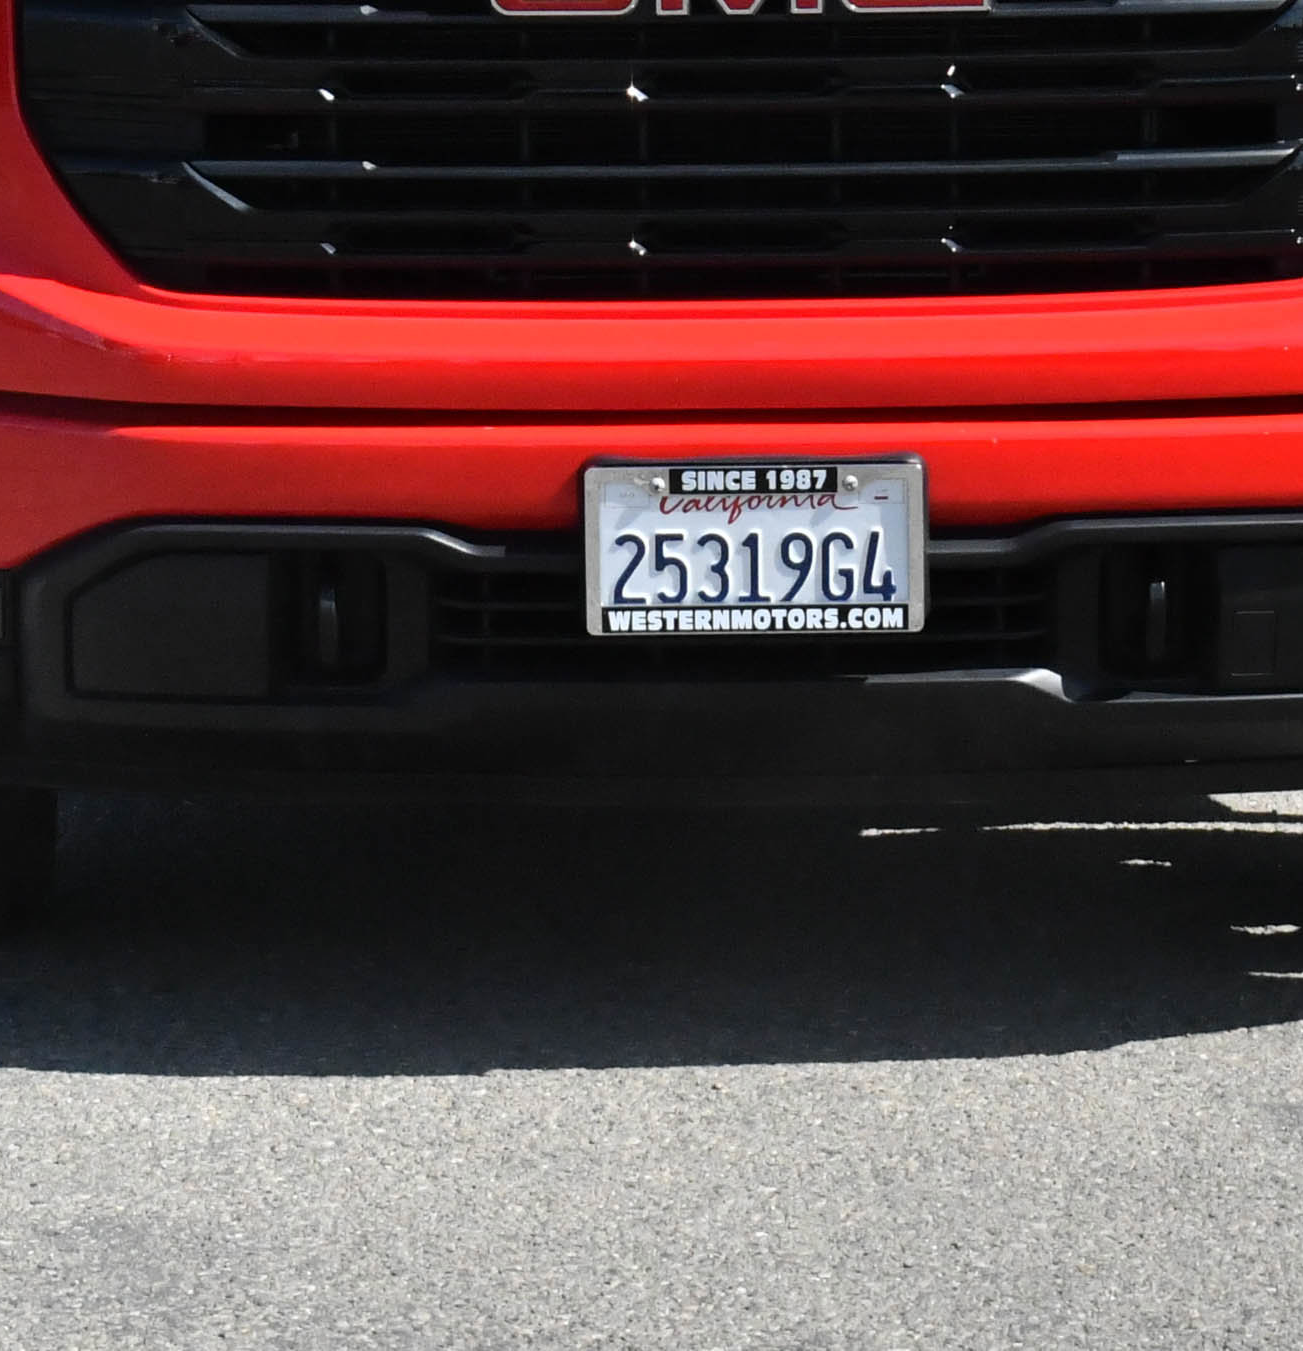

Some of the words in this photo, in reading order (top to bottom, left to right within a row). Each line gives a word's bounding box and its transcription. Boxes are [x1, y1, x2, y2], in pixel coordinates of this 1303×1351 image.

[681, 470, 756, 491] SINCE
[766, 469, 827, 491] 1987
[659, 493, 859, 524] California
[613, 530, 897, 604] 25319G4
[608, 607, 904, 632] WESTERNMOTORS.COM
